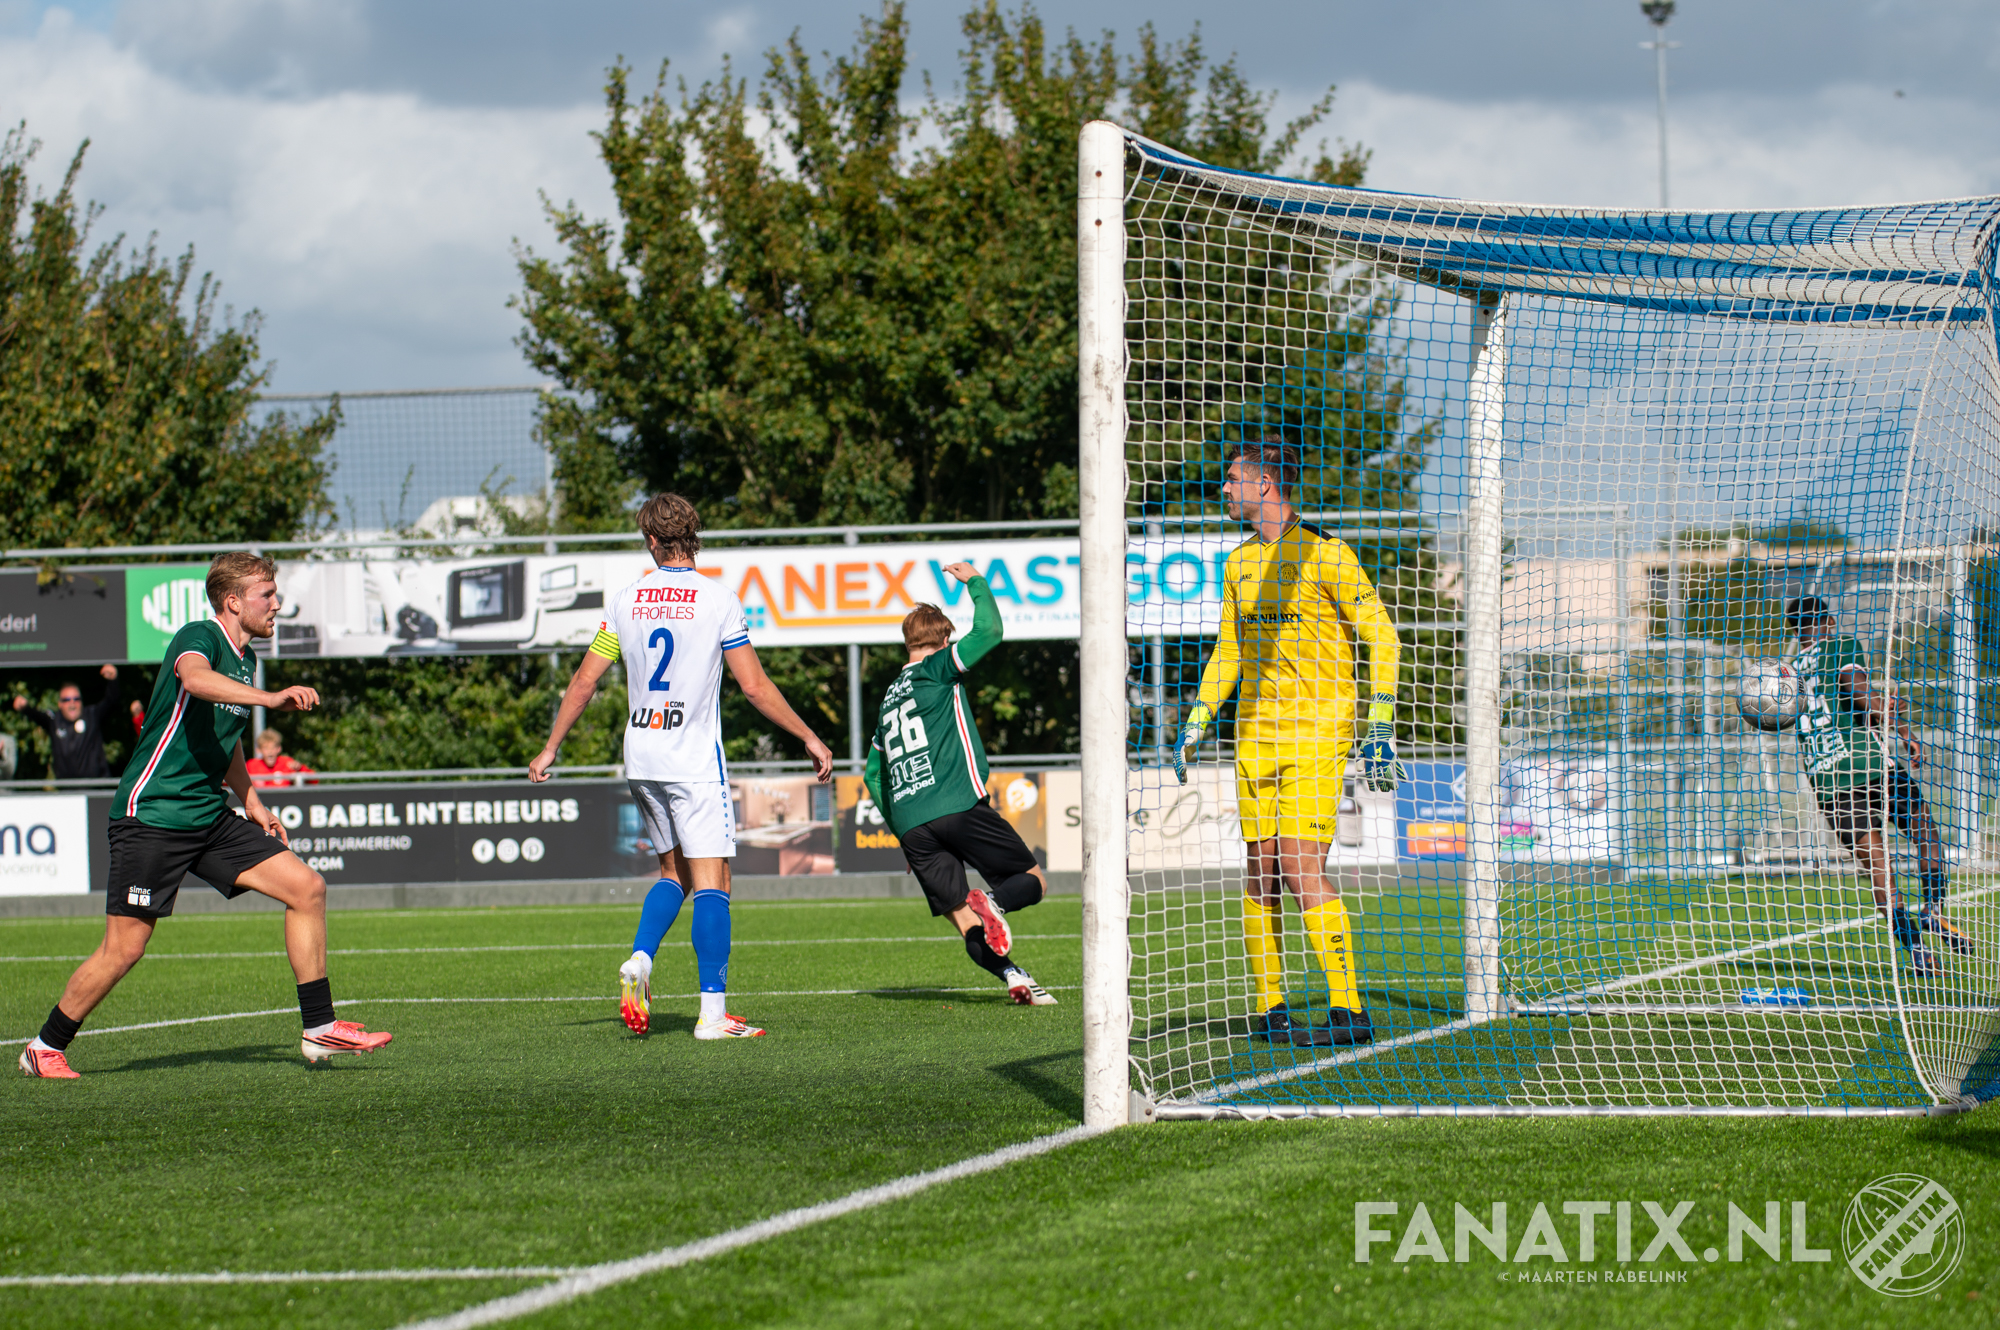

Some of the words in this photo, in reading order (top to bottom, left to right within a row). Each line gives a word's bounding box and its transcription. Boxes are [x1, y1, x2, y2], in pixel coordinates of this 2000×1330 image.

[634, 587, 698, 603] FINISH
[632, 606, 695, 620] PROFILES
[648, 627, 674, 692] 2
[882, 697, 929, 764] 26
[309, 803, 401, 829] BABEL
[405, 798, 580, 826] INTERIEURS
[1308, 821, 1326, 831] JAKO
[313, 837, 327, 853] 21
[328, 834, 412, 852] PURMEREND
[855, 829, 901, 849] beke
[128, 884, 152, 895] simac
